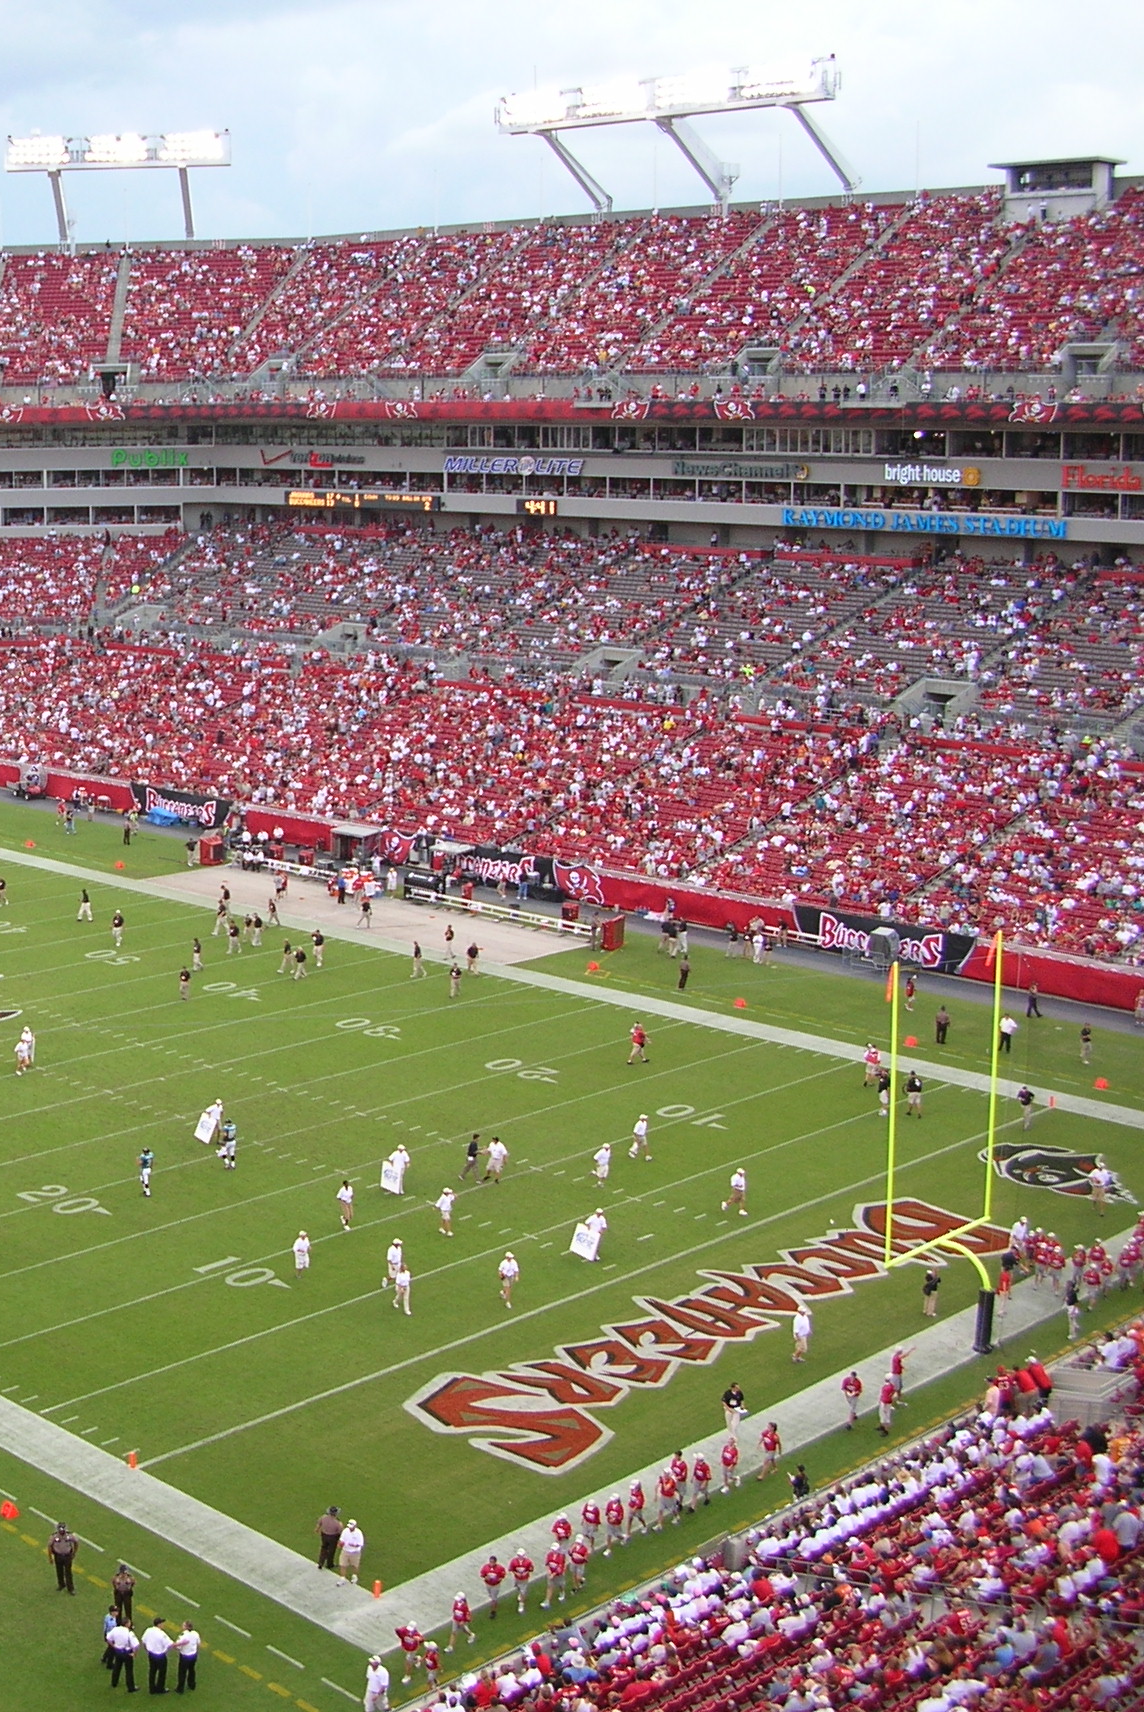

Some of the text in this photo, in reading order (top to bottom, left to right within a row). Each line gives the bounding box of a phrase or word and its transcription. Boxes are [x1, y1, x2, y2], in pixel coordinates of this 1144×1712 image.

[112, 449, 188, 467] Publix
[443, 455, 584, 476] MILLER LITE
[922, 467, 960, 483] house
[1060, 466, 1142, 490] Florida
[424, 502, 430, 510] 2
[782, 508, 1068, 538] RAYMOND JAMES STADIUM
[17, 1184, 106, 1216] 20
[193, 1255, 276, 1288] 10
[404, 1197, 1012, 1475] BUCCANEERS
